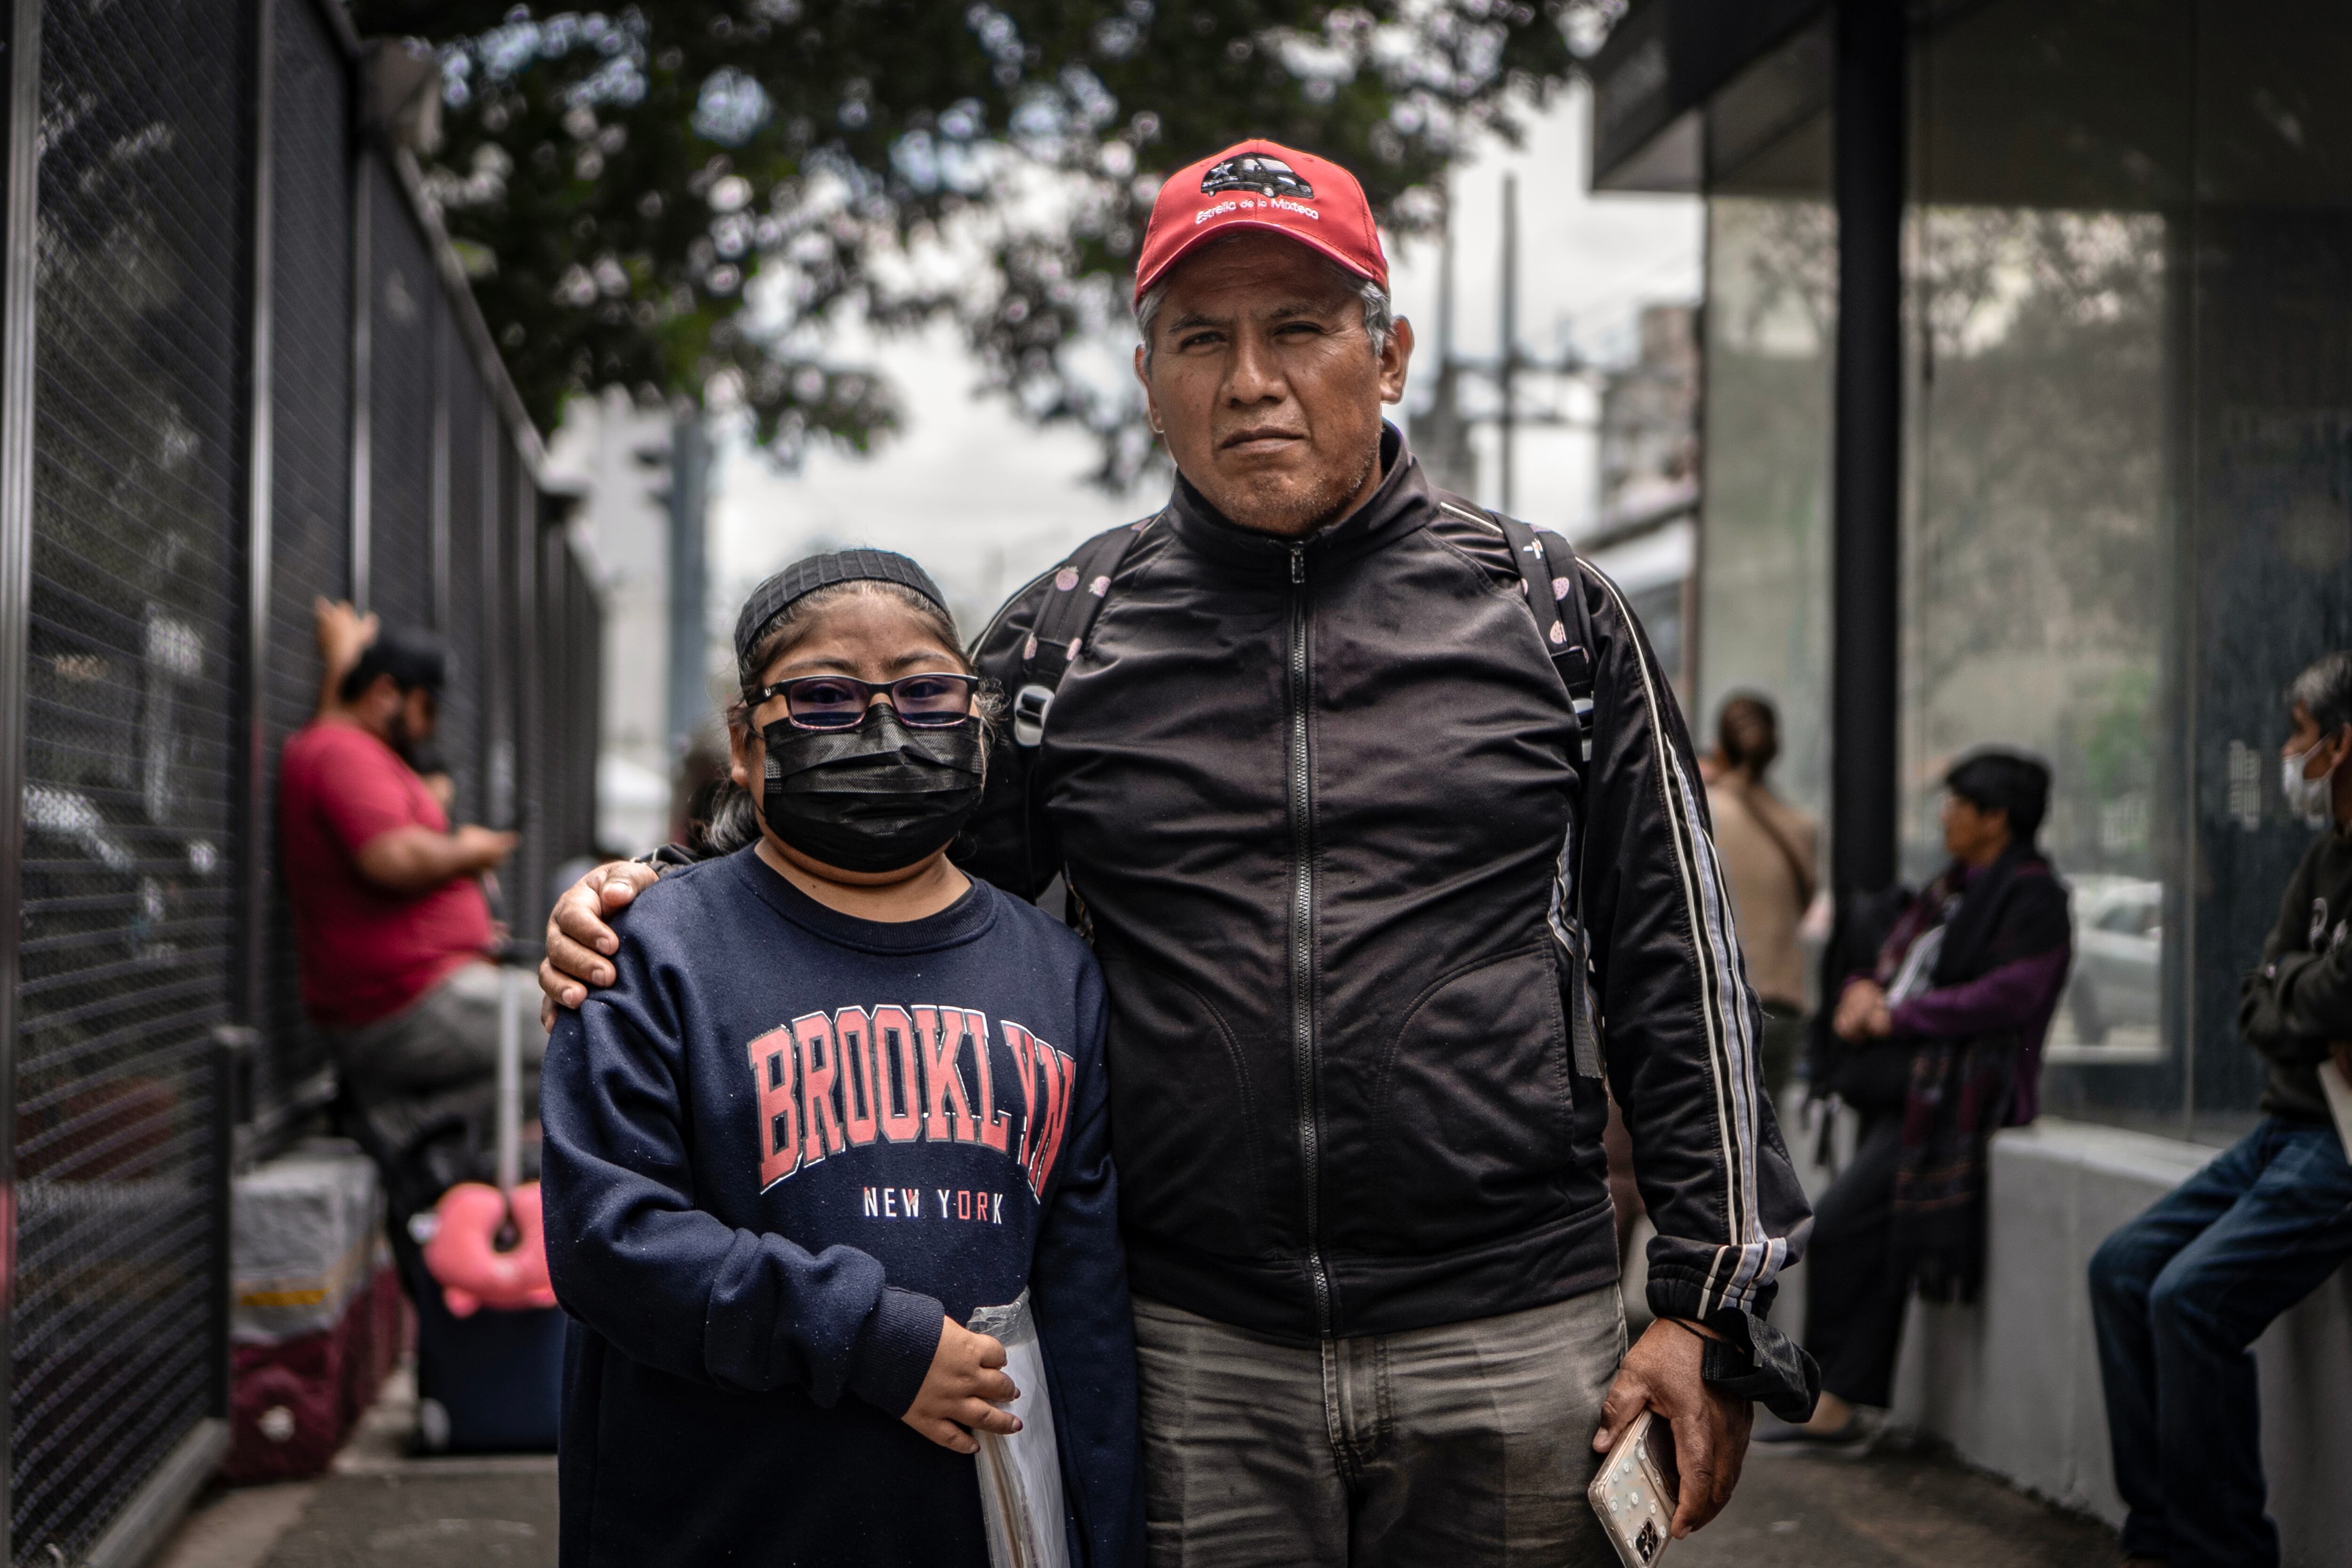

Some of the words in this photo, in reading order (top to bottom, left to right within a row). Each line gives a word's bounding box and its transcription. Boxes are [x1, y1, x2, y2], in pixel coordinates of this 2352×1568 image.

[1195, 201, 1237, 225] Estrella
[1240, 199, 1255, 208] de
[1257, 198, 1267, 207] la
[1271, 198, 1319, 220] Mixteca
[747, 1004, 1076, 1204] BROOKLYN
[864, 1186, 919, 1217] NEW
[938, 1189, 1002, 1224] YORK
